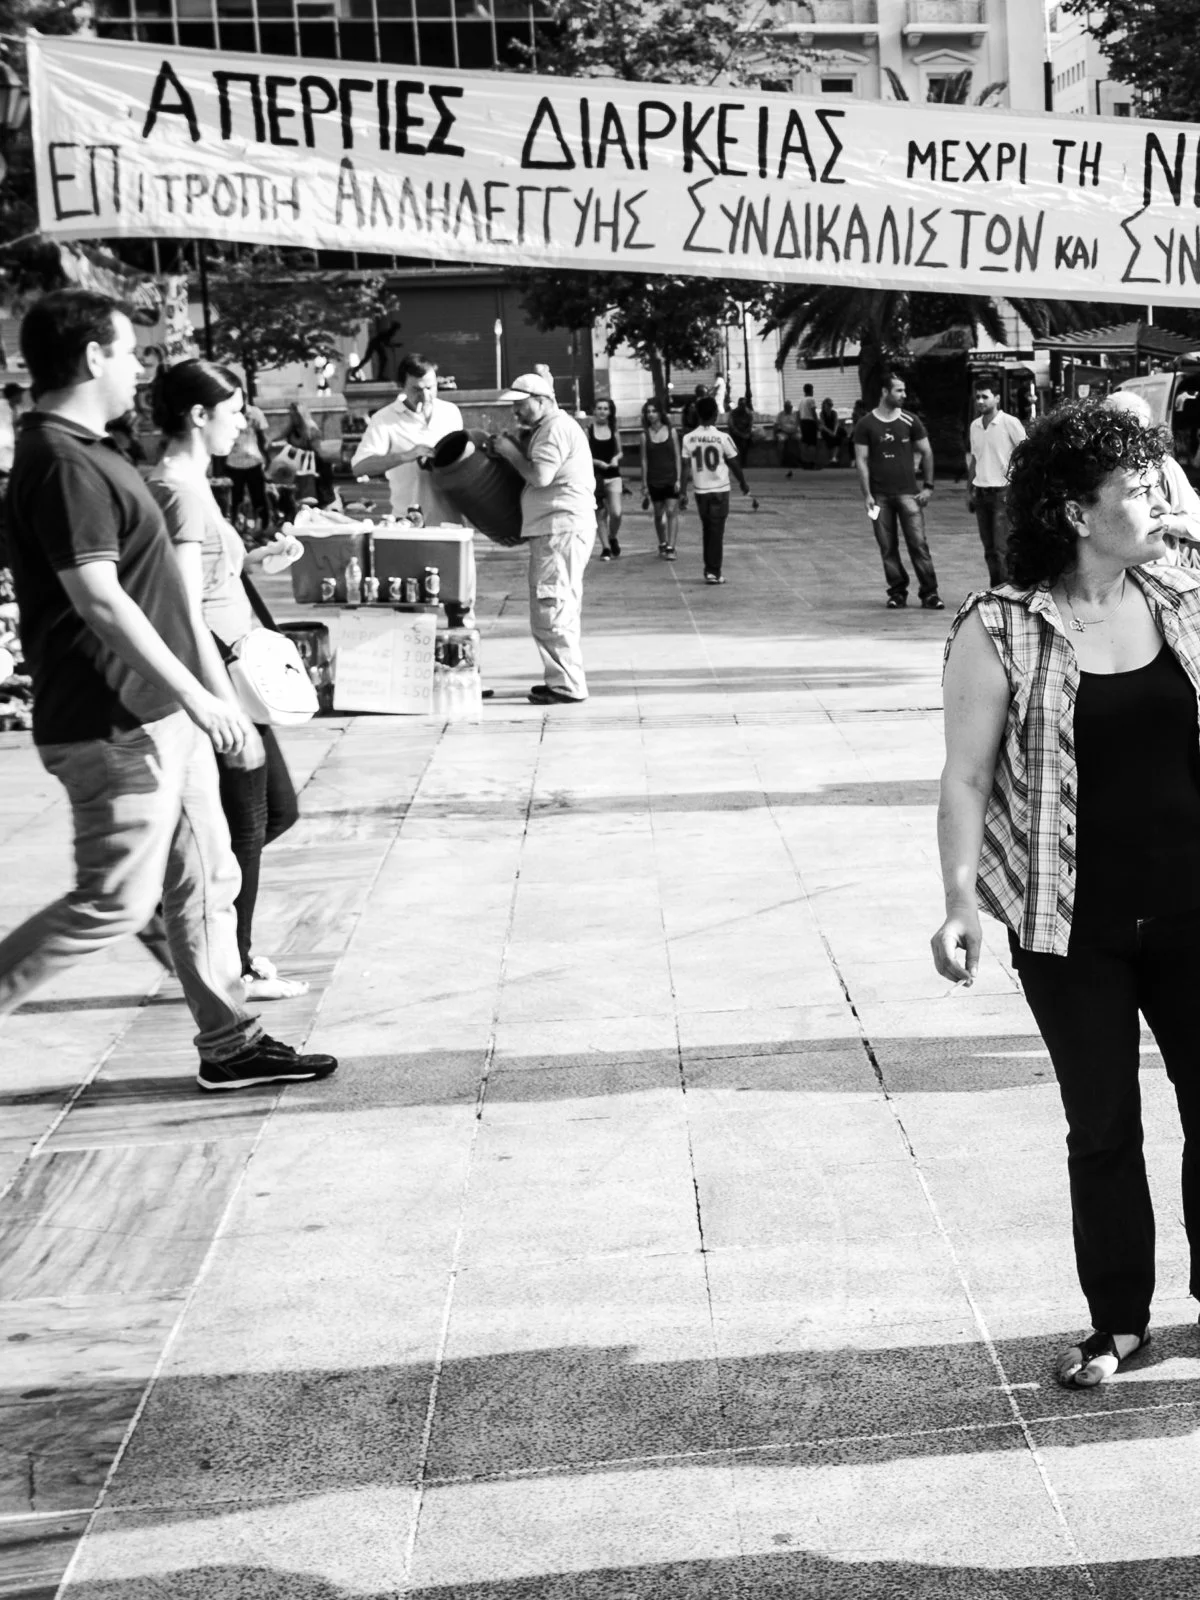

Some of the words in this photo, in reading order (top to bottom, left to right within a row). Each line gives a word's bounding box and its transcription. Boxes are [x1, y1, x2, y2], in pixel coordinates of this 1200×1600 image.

[142, 60, 465, 157] ΑΠΕΡΓΙΕΣ
[521, 96, 846, 184] ΔΙΑΡΚΕΙΑΣ
[907, 139, 1027, 185] ΜΕΧΡΙ
[1052, 139, 1101, 187] ΤΗ
[335, 156, 656, 252] ΑΛΛΗΛΕΓΓΥΗΣ
[682, 176, 1045, 273] ΣΥΝΔΙΚΑΛΙΣΤΩΝ
[692, 445, 720, 472] 10
